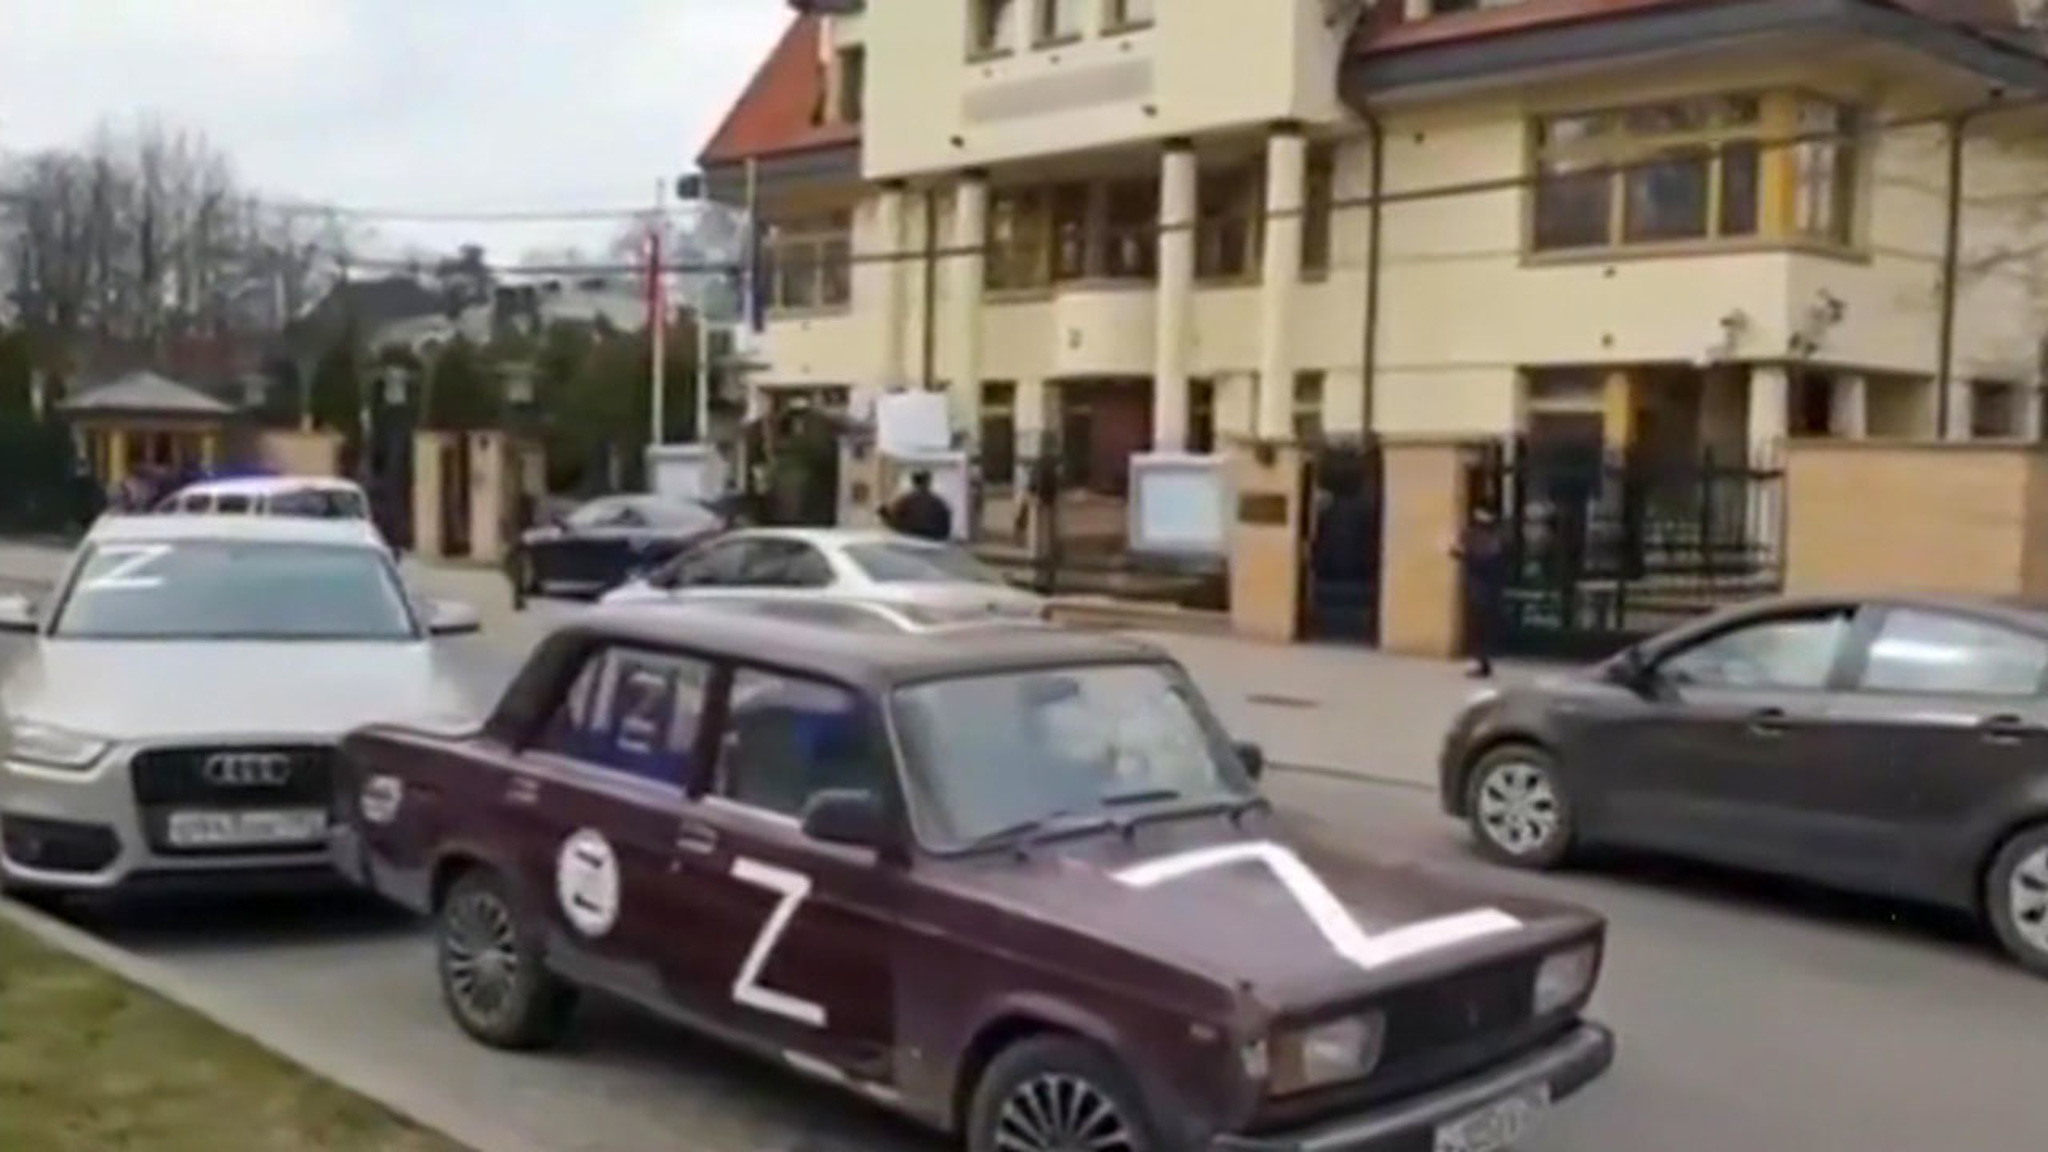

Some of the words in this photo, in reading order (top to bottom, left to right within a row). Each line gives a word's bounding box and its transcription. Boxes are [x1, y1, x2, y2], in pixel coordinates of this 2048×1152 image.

[88, 545, 171, 590] Z
[730, 856, 828, 1028] Z
[1109, 841, 1523, 969] Z
